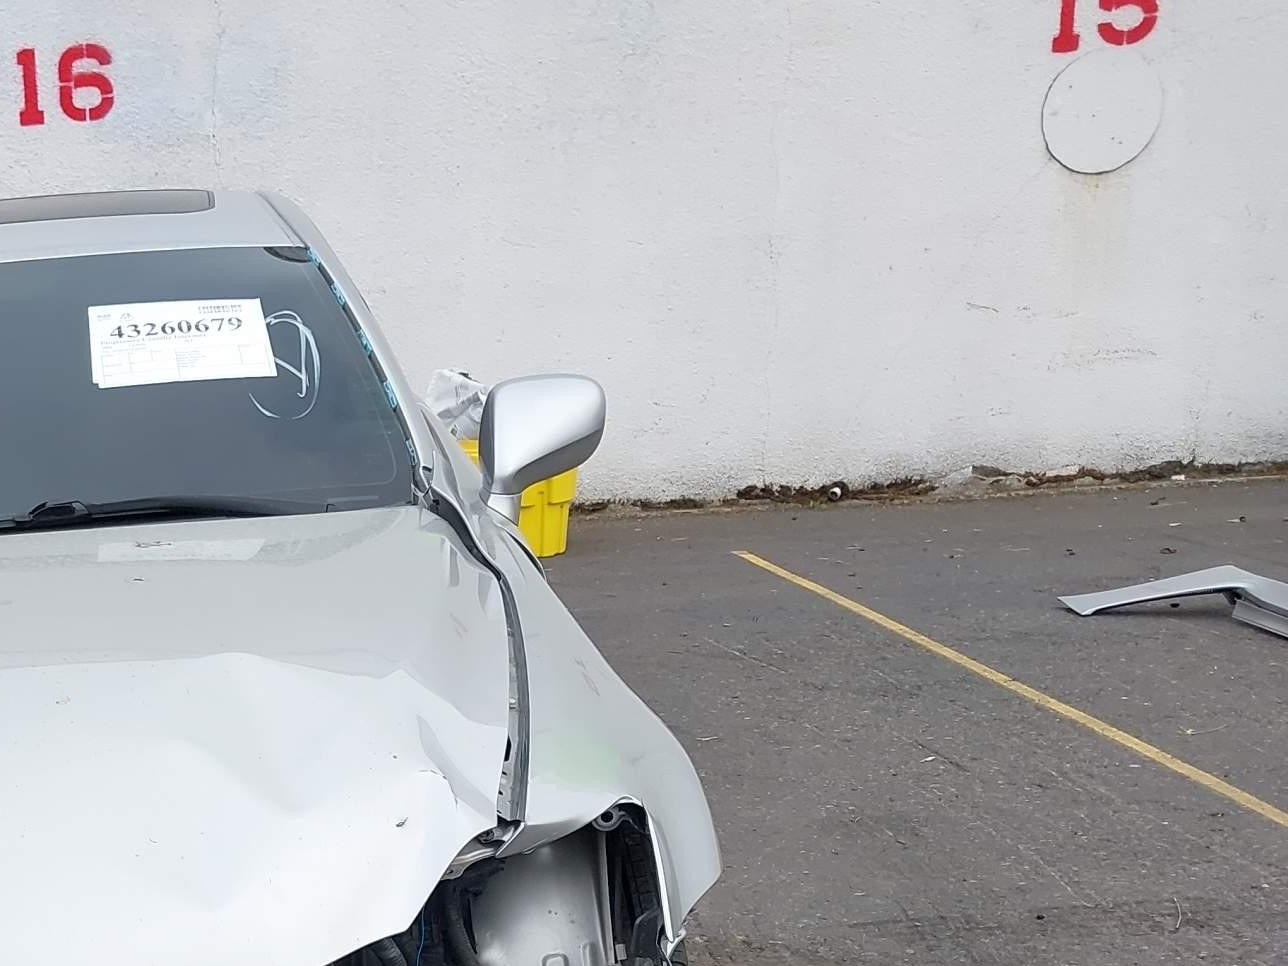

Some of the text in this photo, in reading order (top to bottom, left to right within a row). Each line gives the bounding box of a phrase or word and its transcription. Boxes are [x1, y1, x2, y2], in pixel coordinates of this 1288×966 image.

[1052, 0, 1158, 53] 15
[16, 43, 114, 126] 16
[109, 316, 243, 340] 43260679
